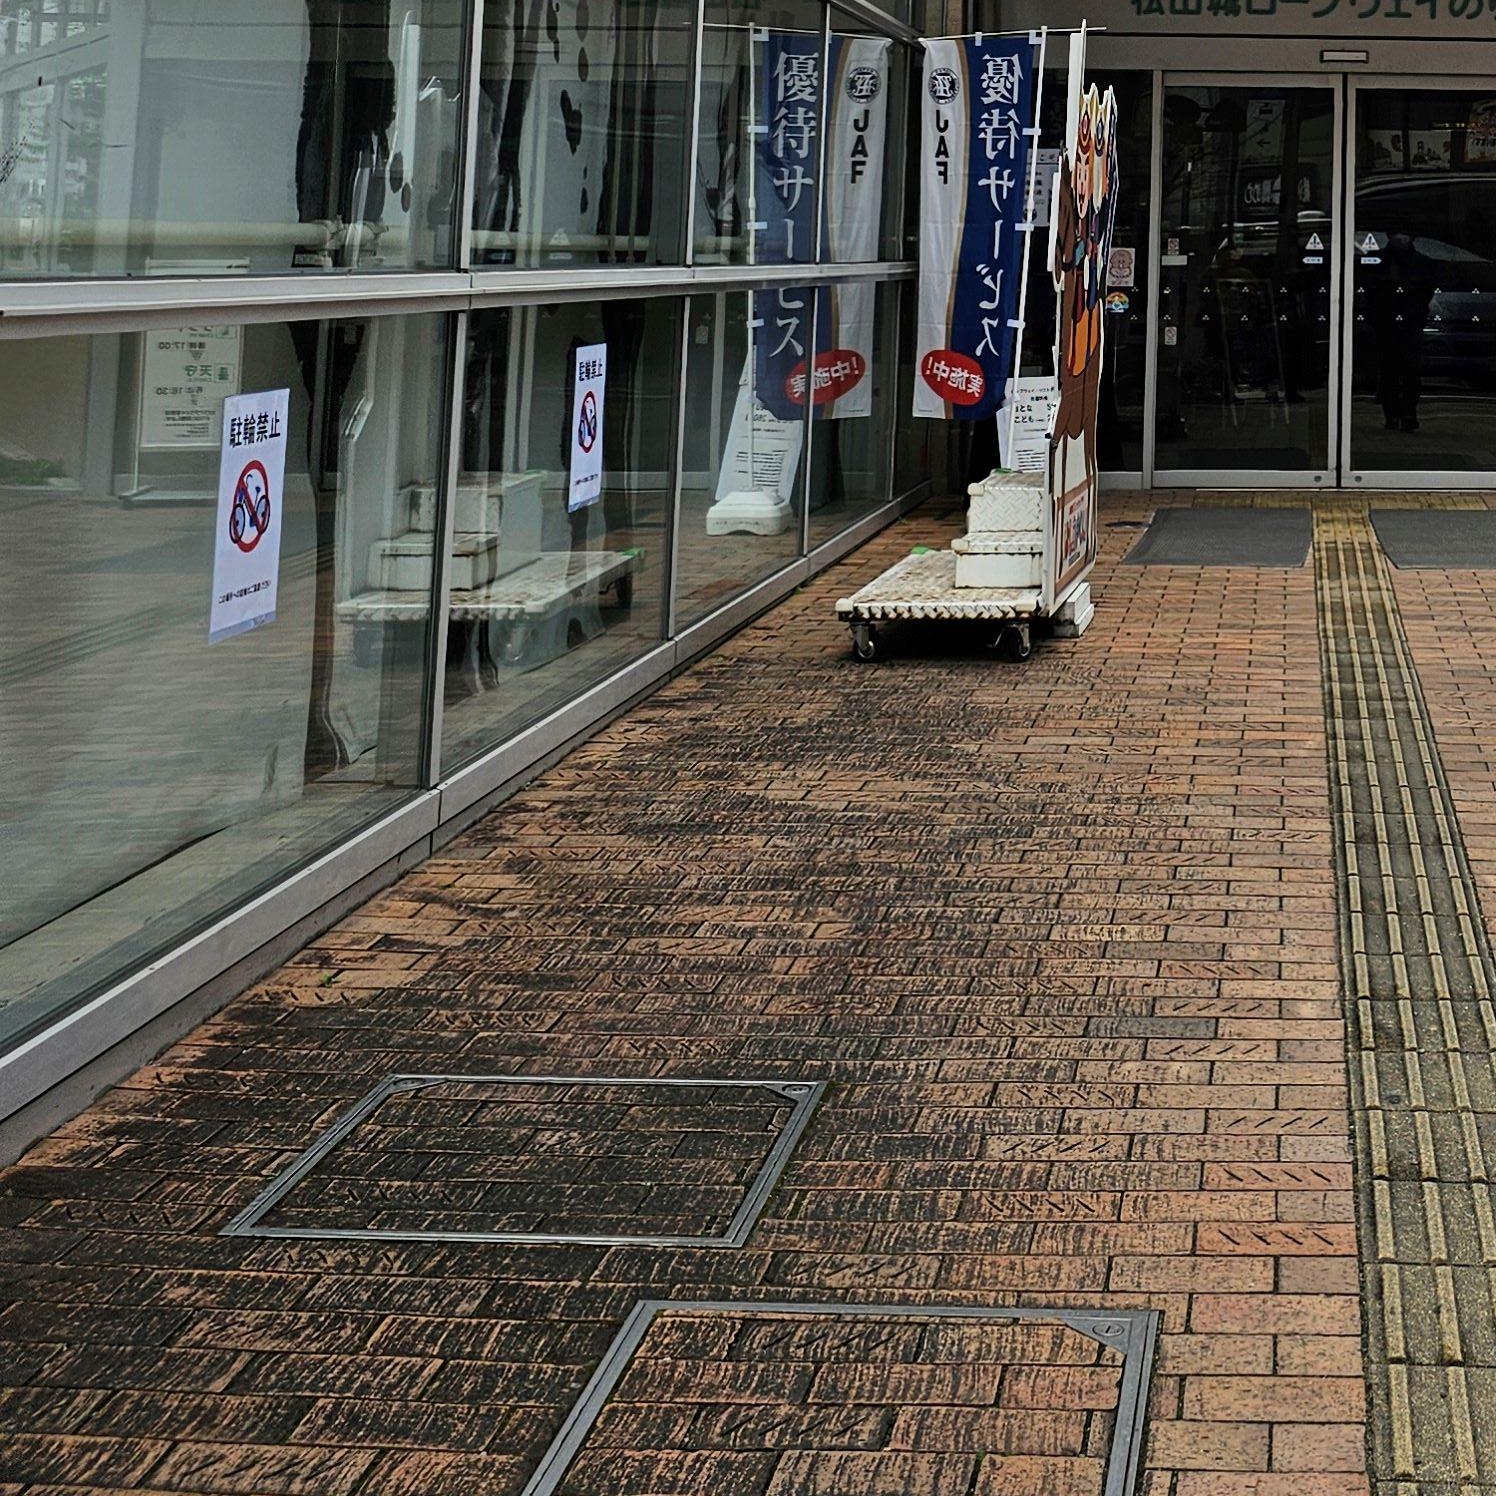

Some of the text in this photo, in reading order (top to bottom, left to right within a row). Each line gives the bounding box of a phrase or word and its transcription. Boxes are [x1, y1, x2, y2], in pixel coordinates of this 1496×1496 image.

[850, 109, 870, 184] JAF
[229, 410, 281, 448] 駐輪禁止
